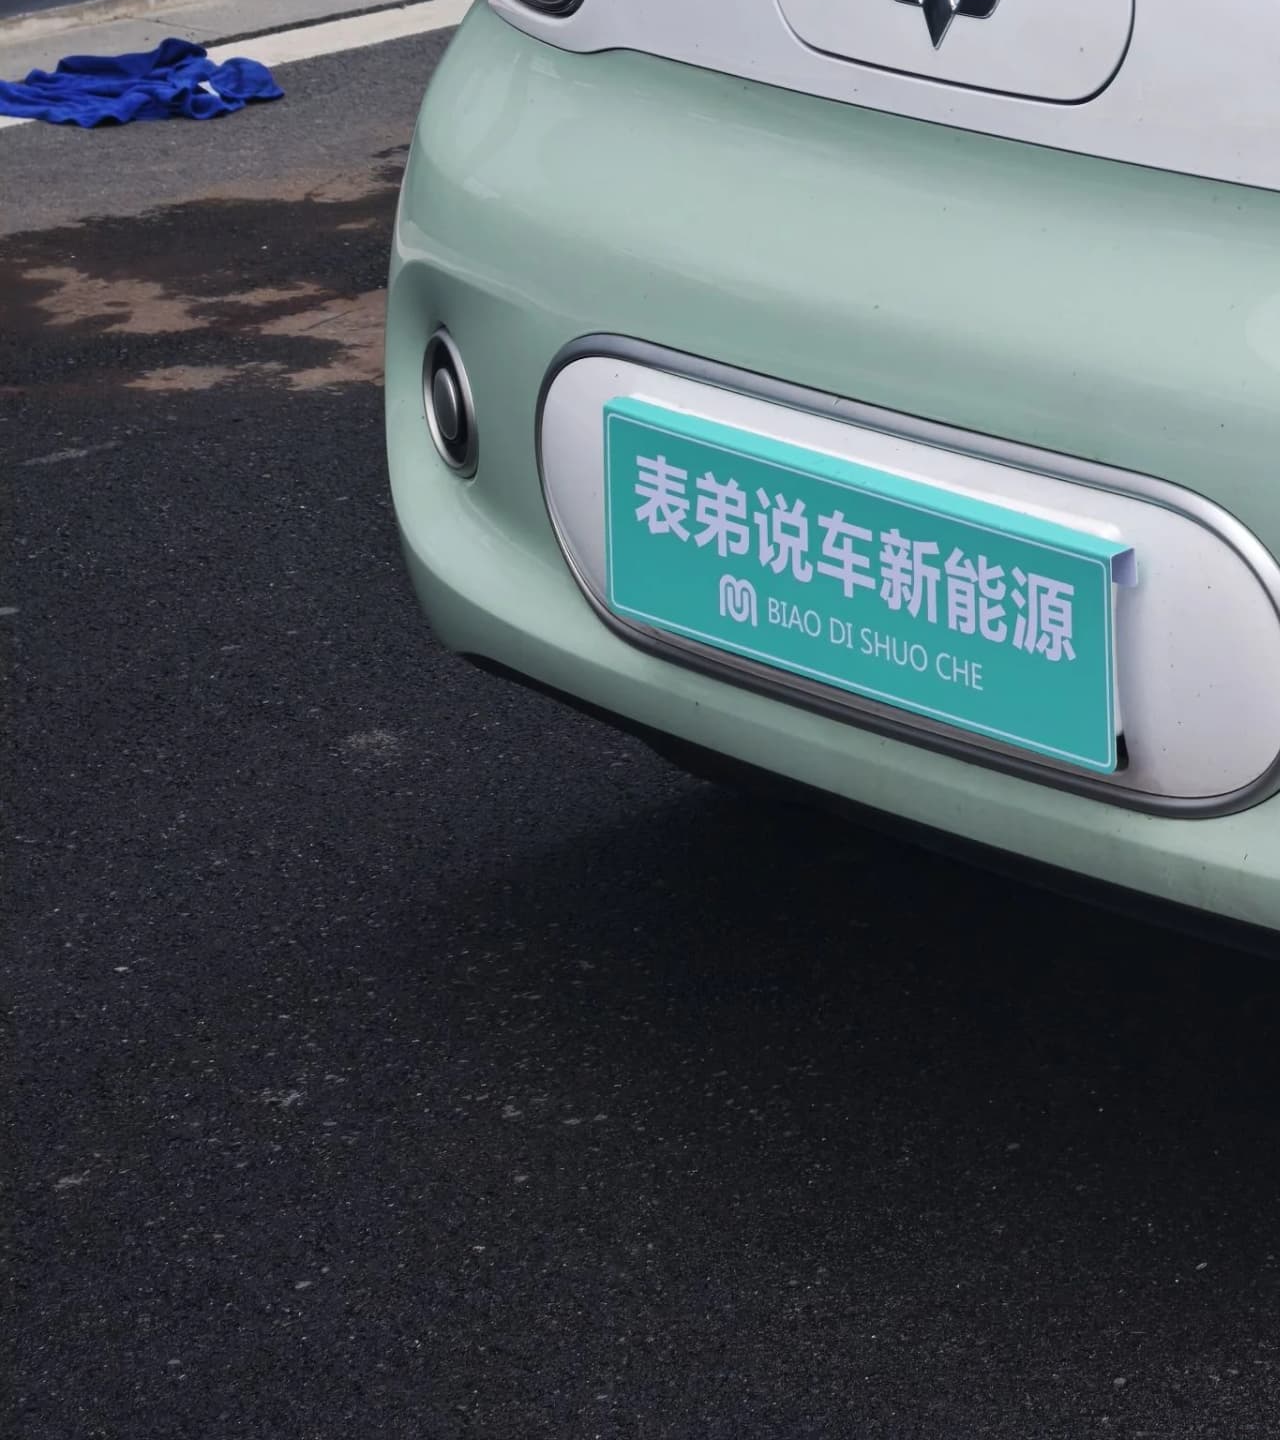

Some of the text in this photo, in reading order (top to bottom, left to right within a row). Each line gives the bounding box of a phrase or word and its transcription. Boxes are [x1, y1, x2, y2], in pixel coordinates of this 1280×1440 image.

[634, 455, 1077, 662] 表弟说车新能源
[767, 596, 984, 691] BIAO DI SHUO CHE
